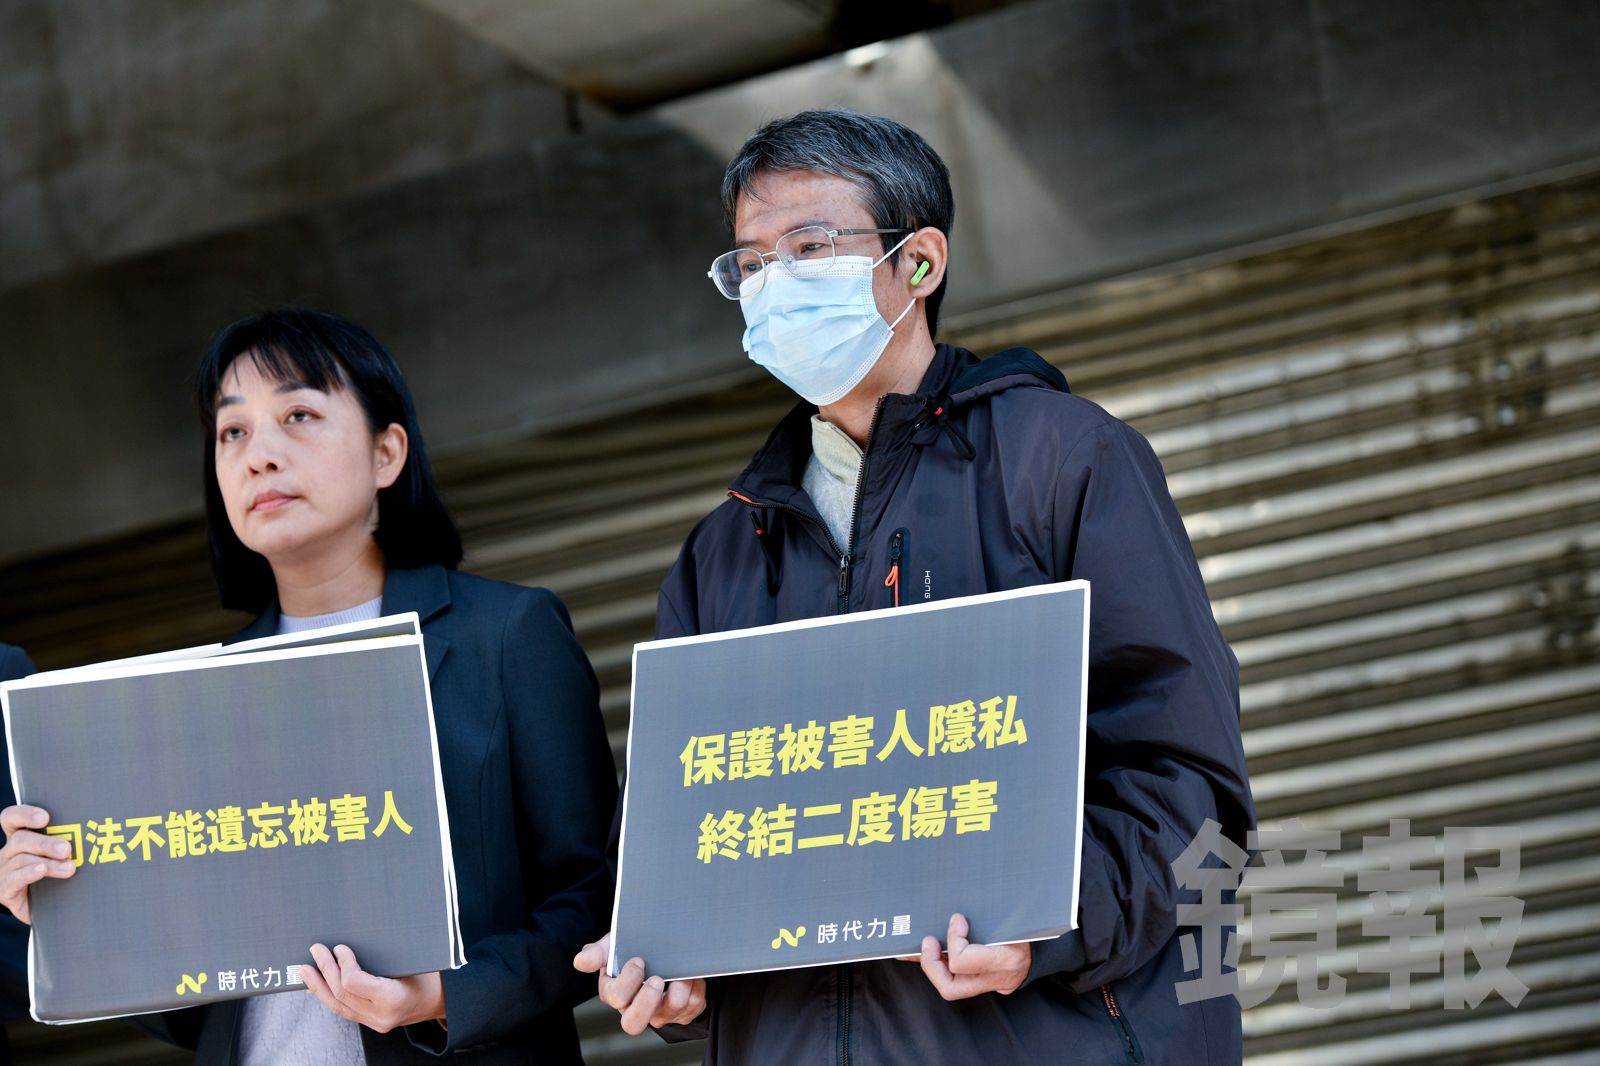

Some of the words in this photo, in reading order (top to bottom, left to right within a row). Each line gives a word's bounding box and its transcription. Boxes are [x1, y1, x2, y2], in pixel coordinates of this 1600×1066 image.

[679, 695, 1028, 787] 保護被害人隱私
[696, 778, 998, 864] 終結二度傷害
[817, 914, 912, 945] 時代力量
[217, 964, 303, 991] 時代力量
